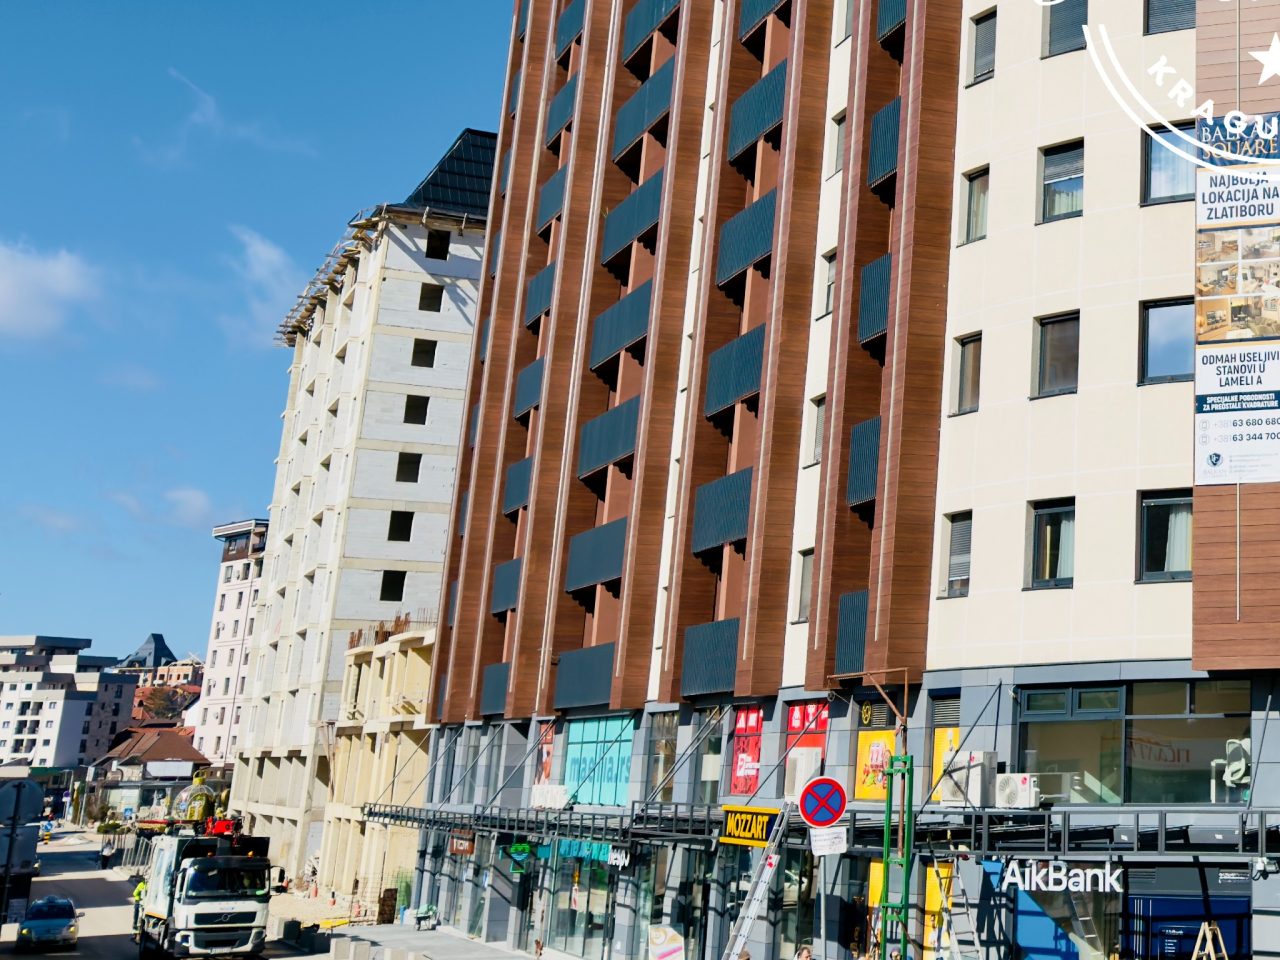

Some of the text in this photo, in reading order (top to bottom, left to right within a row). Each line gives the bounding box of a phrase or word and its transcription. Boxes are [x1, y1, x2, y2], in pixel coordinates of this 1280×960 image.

[1202, 187, 1280, 205] LOKACIJA NA
[1207, 203, 1274, 220] ZLATIBORU
[1202, 350, 1280, 366] ODMAH USELJIVI
[1216, 362, 1266, 376] STANOVI U
[1219, 375, 1263, 387] LAMELI A
[1232, 419, 1244, 427] 63
[1232, 434, 1244, 442] 63
[1246, 433, 1263, 441] 344
[726, 813, 769, 839] MOZZART
[1001, 859, 1124, 892] AikBank
